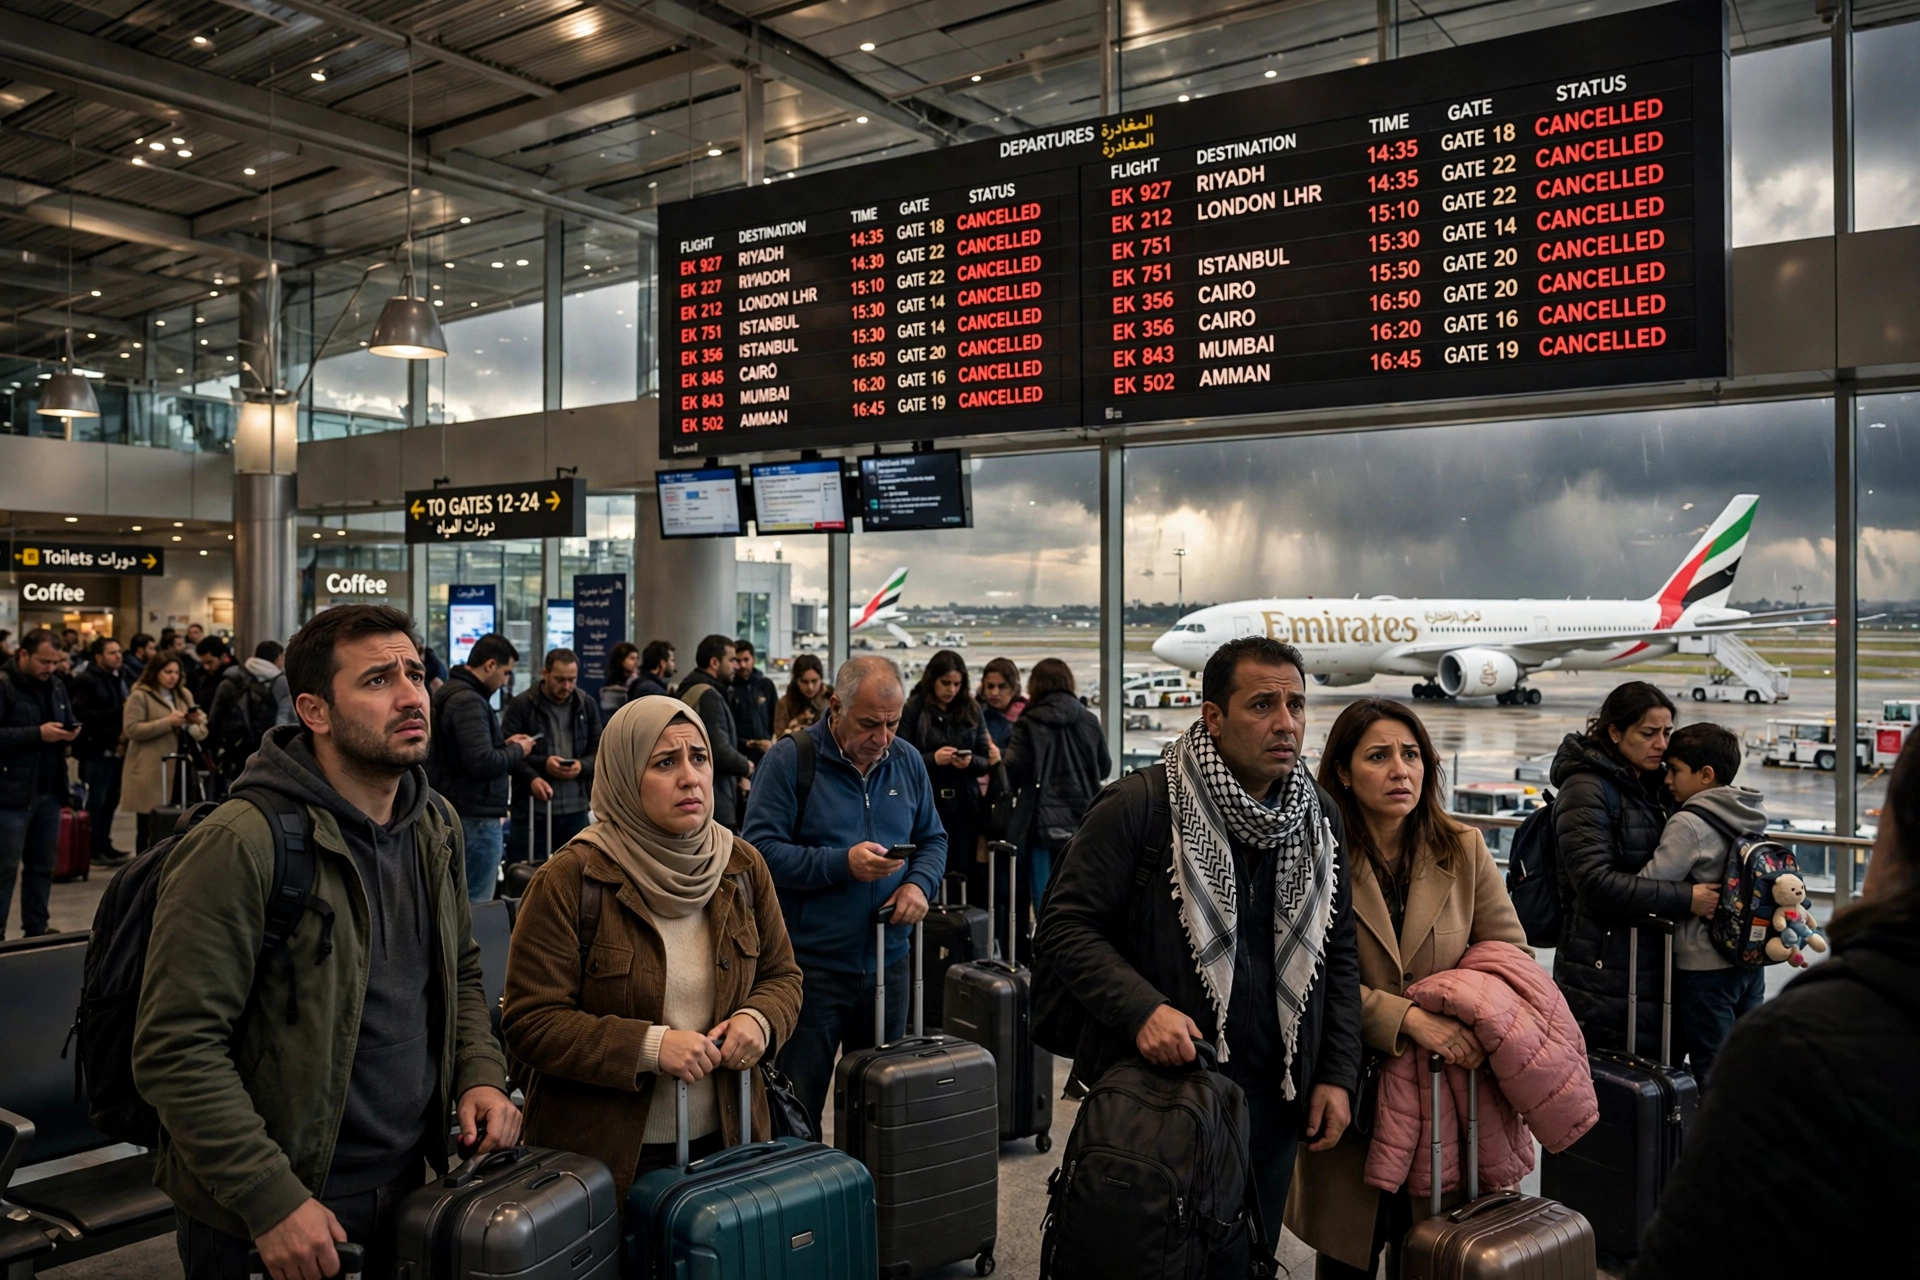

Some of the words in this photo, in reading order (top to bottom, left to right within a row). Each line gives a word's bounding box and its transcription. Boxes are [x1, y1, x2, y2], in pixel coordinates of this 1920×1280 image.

[1000, 125, 1095, 158] DEPARTURES
[1101, 114, 1153, 140] المغادرة
[1103, 132, 1154, 158] المغادرة
[1111, 158, 1160, 179] FLIGHT
[1197, 133, 1296, 164] DESTINATION
[1369, 113, 1409, 134] TIME
[1448, 99, 1492, 120] GATE
[1557, 75, 1626, 101] STATUS
[1111, 187, 1134, 206] EK
[1140, 181, 1171, 201] 927
[1197, 165, 1264, 192] RIYADH
[1367, 139, 1418, 163] 14:35
[1441, 129, 1485, 151] GATE
[1493, 123, 1515, 143] 18
[1535, 98, 1663, 136] CANCELLED
[1112, 214, 1134, 233] EK
[1141, 208, 1172, 229] 212
[1198, 191, 1275, 220] LONDON
[1284, 185, 1322, 207] LHR
[1368, 169, 1418, 193] 14:35
[1442, 160, 1485, 181] GATE
[1492, 155, 1516, 175] 22
[1536, 131, 1663, 168] CANCELLED
[1112, 241, 1134, 260] EK
[1141, 236, 1170, 256] 751
[1369, 200, 1419, 223] 15:10
[1442, 190, 1486, 212] GATE
[1493, 186, 1516, 205] 22
[1536, 164, 1664, 199] CANCELLED
[681, 237, 714, 253] FLIGHT
[739, 220, 806, 243] DESTINATION
[851, 207, 877, 223] TIME
[900, 198, 929, 215] GATE
[969, 183, 1015, 203] STATUS
[681, 260, 696, 276] EK
[700, 256, 722, 272] 927
[739, 246, 784, 266] RIYADH
[851, 229, 884, 247] 14:35
[897, 222, 925, 239] GATE
[930, 219, 944, 234] 18
[957, 203, 1041, 230] CANCELLED
[1113, 268, 1135, 287] EK
[1142, 263, 1171, 283] 751
[1199, 248, 1290, 275] ISTANBUL
[1369, 229, 1420, 252] 15:30
[1443, 221, 1486, 242] GATE
[1495, 217, 1517, 235] 14
[1537, 196, 1664, 231] CANCELLED
[680, 283, 696, 298] EK
[851, 253, 884, 271] 14:30
[897, 247, 925, 264] GATE
[929, 244, 944, 259] 22
[957, 229, 1041, 256] CANCELLED
[681, 305, 697, 321] EK
[701, 301, 722, 318] 212
[739, 291, 788, 312] LONDON
[793, 287, 817, 304] LHR
[851, 277, 884, 295] 15:10
[897, 272, 925, 289] GATE
[929, 269, 945, 284] 22
[957, 255, 1041, 281] CANCELLED
[1113, 295, 1135, 314] EK
[1142, 291, 1174, 310] 356
[1198, 281, 1255, 303] CAIRO
[1369, 260, 1420, 282] 15:50
[1443, 252, 1487, 272] GATE
[1494, 248, 1517, 267] 20
[1537, 229, 1665, 262] CANCELLED
[681, 328, 697, 343] EK
[701, 325, 721, 340] 751
[740, 314, 799, 335] ISTANBUL
[852, 302, 885, 319] 15:30
[897, 297, 925, 313] GATE
[930, 295, 945, 309] 14
[958, 281, 1041, 306] CANCELLED
[1113, 322, 1136, 341] EK
[1143, 318, 1174, 337] 356
[1199, 309, 1256, 331] CAIRO
[1370, 290, 1421, 311] 16:50
[1444, 282, 1487, 303] GATE
[1495, 279, 1518, 298] 20
[1538, 262, 1665, 294] CANCELLED
[1114, 349, 1136, 368] EK
[1142, 345, 1174, 365] 843
[1199, 335, 1274, 359] MUMBAI
[1370, 320, 1421, 341] 16:20
[1444, 313, 1488, 333] GATE
[1496, 310, 1518, 328] 16
[1538, 294, 1666, 325] CANCELLED
[681, 350, 698, 366] EK
[702, 347, 723, 363] 356
[739, 338, 798, 358] ISTANBUL
[852, 327, 885, 344] 15:30
[897, 322, 926, 338] GATE
[931, 320, 945, 334] 14
[958, 307, 1042, 332] CANCELLED
[682, 373, 698, 388] EK
[739, 362, 777, 382] CAIRO
[852, 351, 885, 368] 16:50
[898, 347, 926, 363] GATE
[929, 345, 946, 359] 20
[958, 334, 1042, 357] CANCELLED
[1114, 376, 1136, 394] EK
[1144, 373, 1174, 392] 502
[1199, 364, 1270, 387] AMMAN
[1371, 350, 1421, 370] 16:45
[1444, 344, 1488, 363] GATE
[1497, 341, 1518, 359] 19
[1539, 326, 1666, 356] CANCELLED
[682, 396, 698, 410] EK
[702, 393, 724, 408] 843
[740, 386, 789, 404] MUMBAI
[852, 376, 885, 392] 16:20
[898, 372, 926, 388] GATE
[931, 370, 946, 384] 16
[958, 360, 1042, 383] CANCELLED
[682, 418, 698, 433] EK
[702, 416, 723, 431] 502
[740, 409, 787, 427] AMMAN
[853, 401, 885, 417] 16:45
[898, 397, 926, 413] GATE
[932, 395, 946, 410] 19
[959, 386, 1043, 408] CANCELLED
[427, 498, 445, 516] TO
[449, 495, 492, 515] GATES
[497, 492, 539, 512] 12-24
[464, 518, 495, 536] دورات
[43, 549, 93, 565] Toilets
[98, 552, 136, 569] دورات
[327, 574, 387, 594] Coffee
[24, 583, 84, 601] Coffee
[1262, 610, 1418, 643] Emirates
